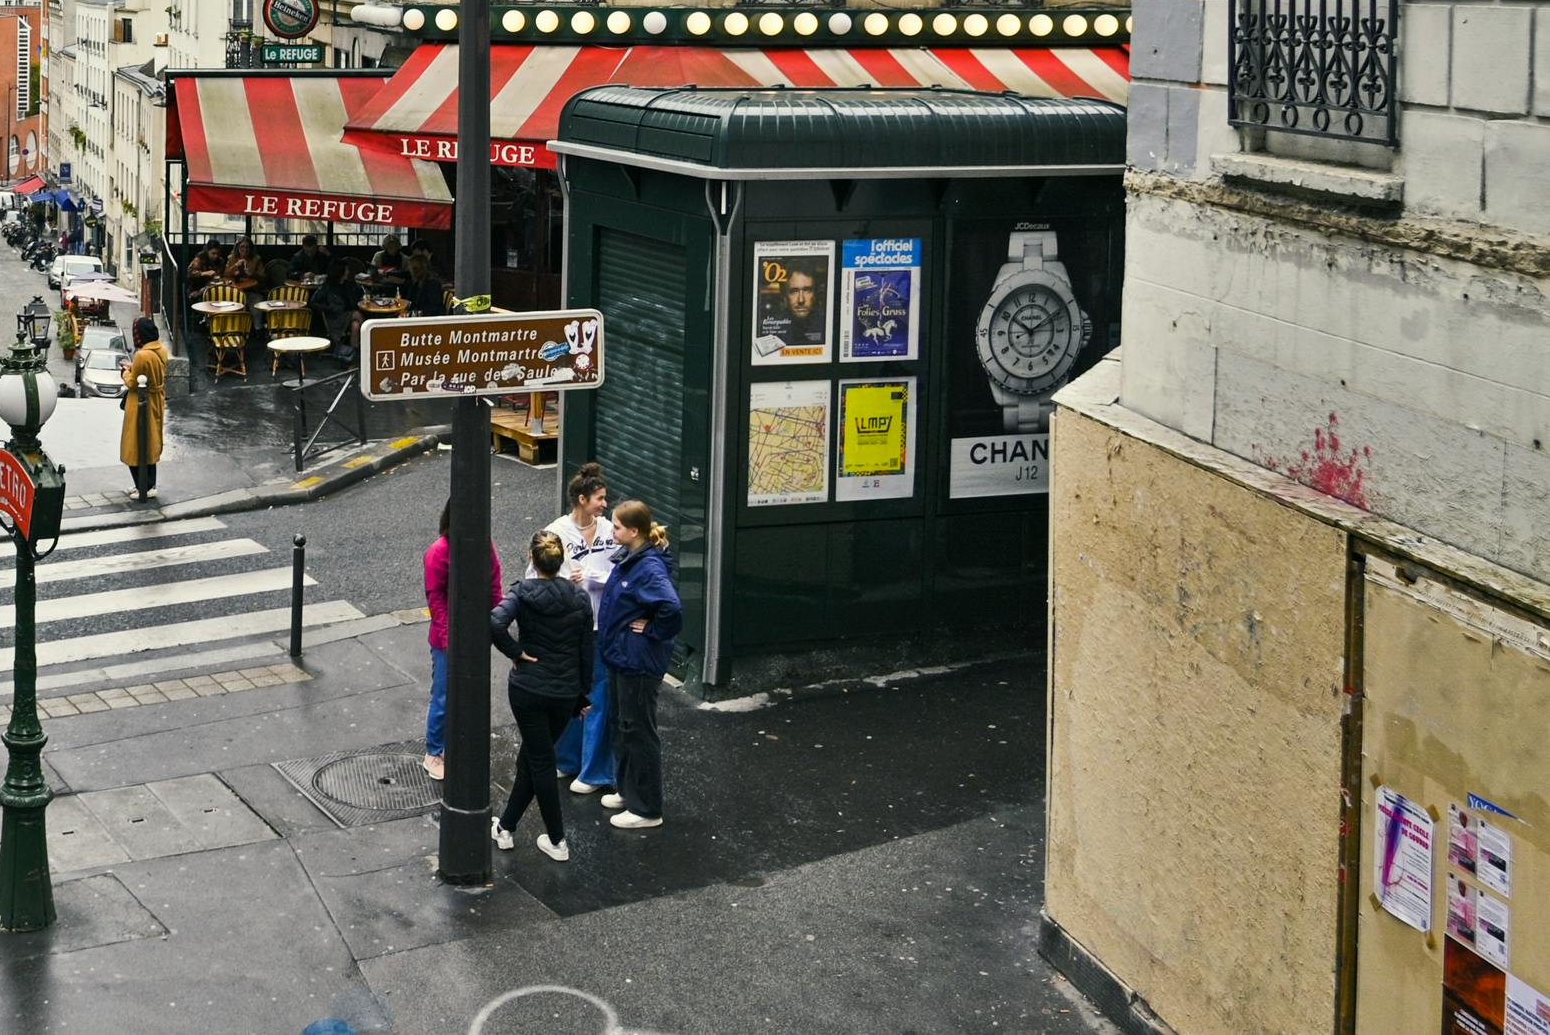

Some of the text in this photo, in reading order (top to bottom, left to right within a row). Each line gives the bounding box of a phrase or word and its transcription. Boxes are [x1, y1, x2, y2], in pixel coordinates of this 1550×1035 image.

[273, 0, 309, 23] Heineken
[265, 48, 318, 60] Le REFUGE
[400, 139, 535, 164] LE RUGE
[244, 195, 393, 223] LE REFUGE
[1014, 221, 1050, 230] JCDecaux
[400, 329, 538, 347] Butte Montmartre
[400, 352, 450, 367] Musée
[457, 347, 543, 364] Montmartre
[400, 372, 426, 386] Par
[517, 364, 557, 381] Saule
[861, 417, 887, 429] LMP
[1015, 465, 1038, 481] J12
